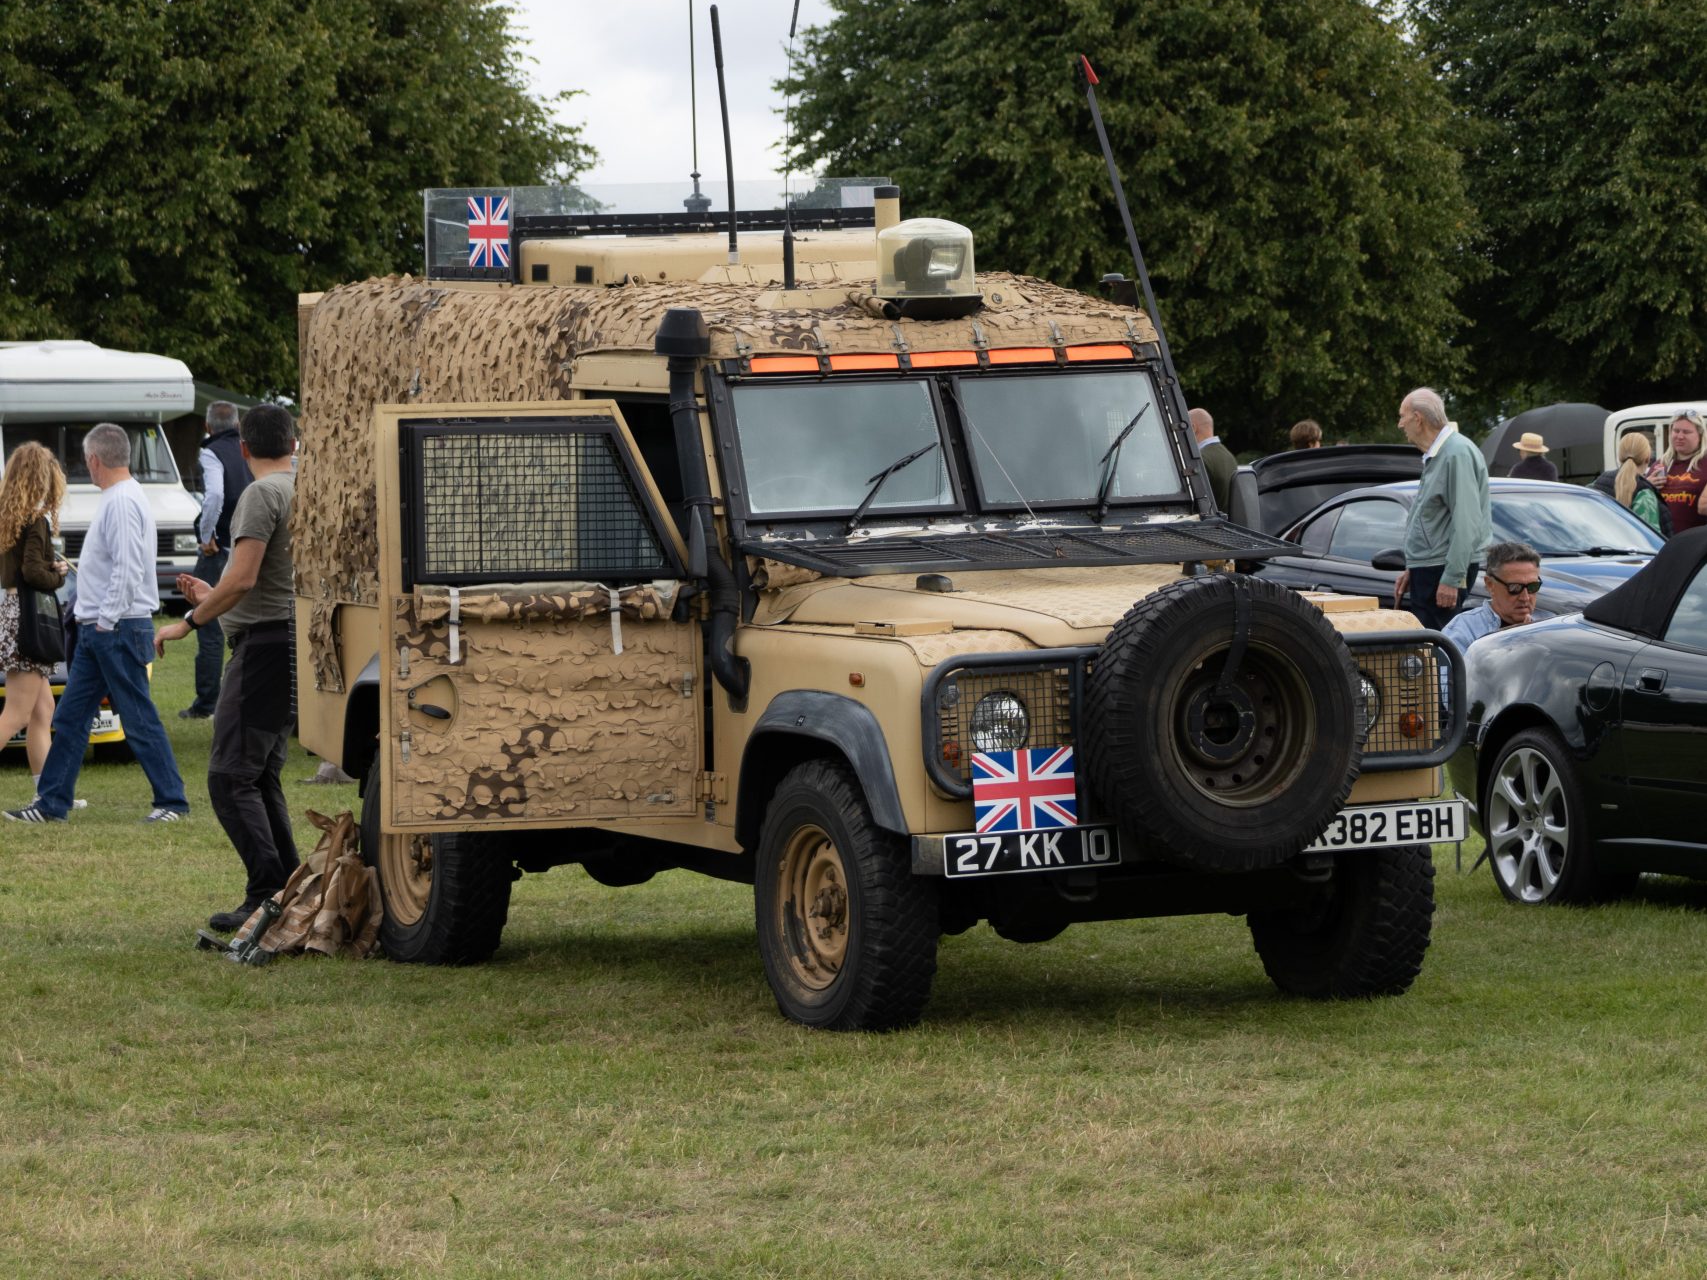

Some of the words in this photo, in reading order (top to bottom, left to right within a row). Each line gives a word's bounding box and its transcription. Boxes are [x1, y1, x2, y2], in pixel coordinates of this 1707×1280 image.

[1660, 491, 1696, 506] perdry
[1396, 806, 1454, 841] EBH
[955, 836, 1002, 872] 27
[1019, 831, 1065, 867] KK
